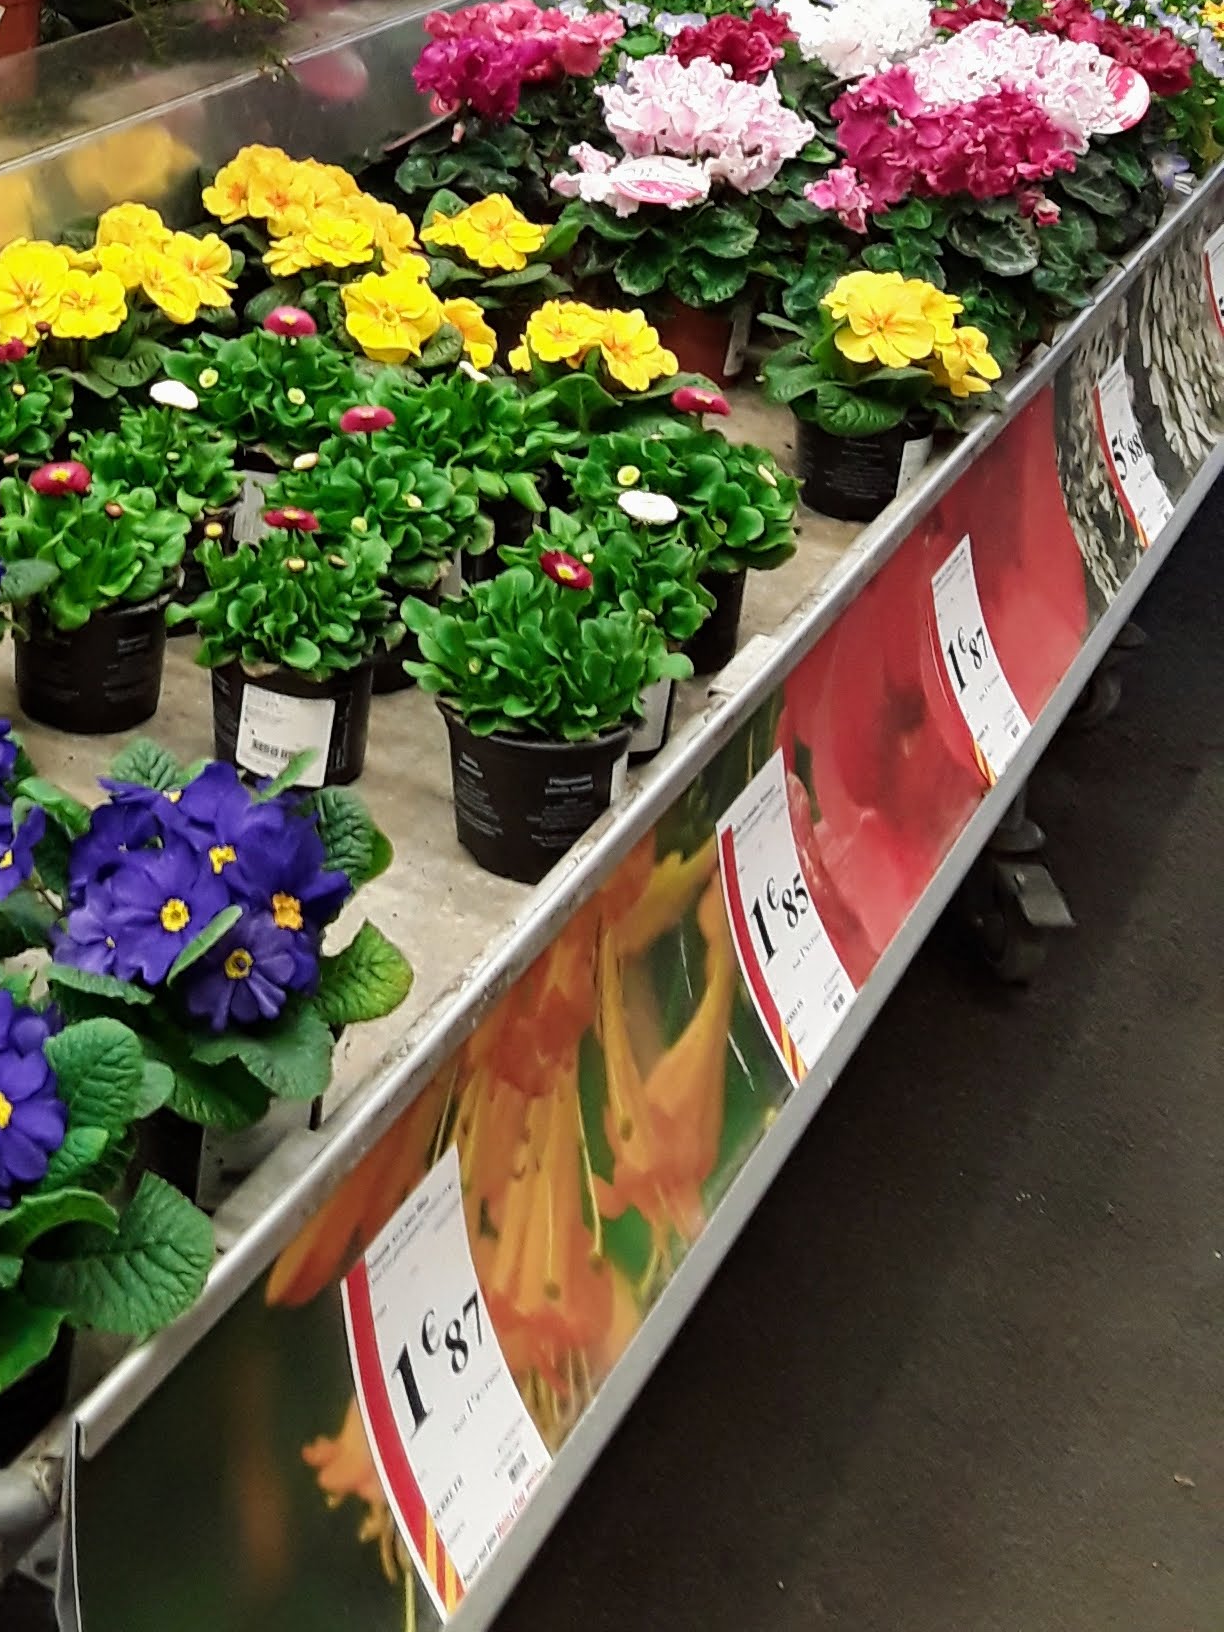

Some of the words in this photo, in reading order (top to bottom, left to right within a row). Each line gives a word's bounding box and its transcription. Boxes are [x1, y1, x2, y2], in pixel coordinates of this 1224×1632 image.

[947, 626, 988, 695] 1€87
[750, 872, 809, 966] 1€85
[391, 1290, 483, 1440] 1€87
